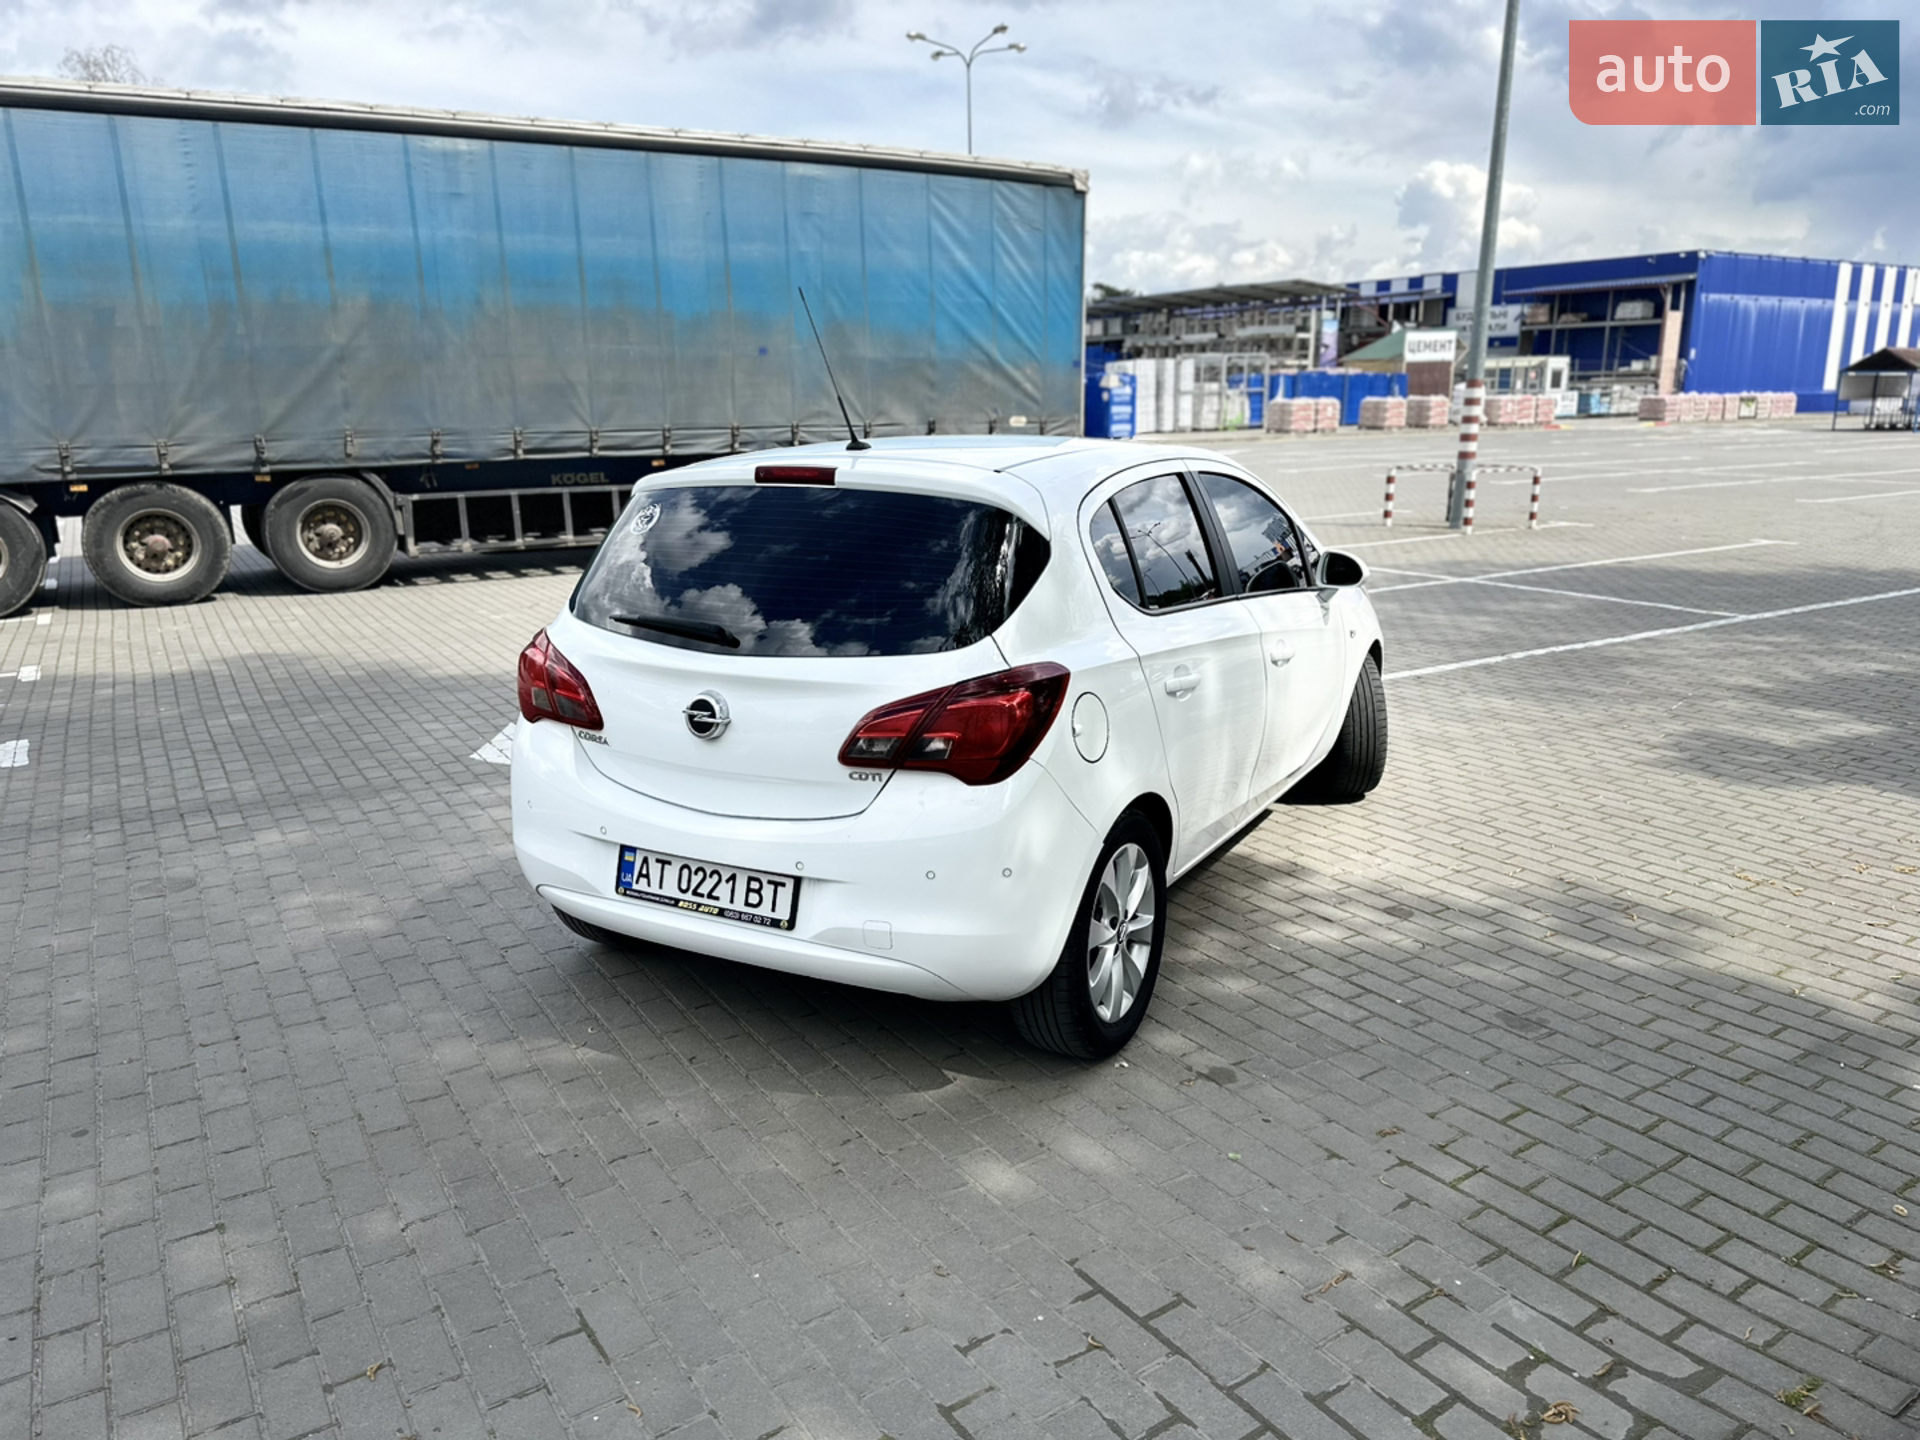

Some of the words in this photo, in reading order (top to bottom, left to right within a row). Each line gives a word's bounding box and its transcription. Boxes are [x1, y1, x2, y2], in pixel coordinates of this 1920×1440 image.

[1408, 340, 1453, 355] ЦЕМЕНТ
[551, 472, 609, 485] KÖGEL
[621, 872, 633, 883] UA
[635, 855, 672, 890] AT
[677, 863, 737, 905] 0221
[744, 875, 787, 913] BT
[698, 904, 720, 915] AUTO
